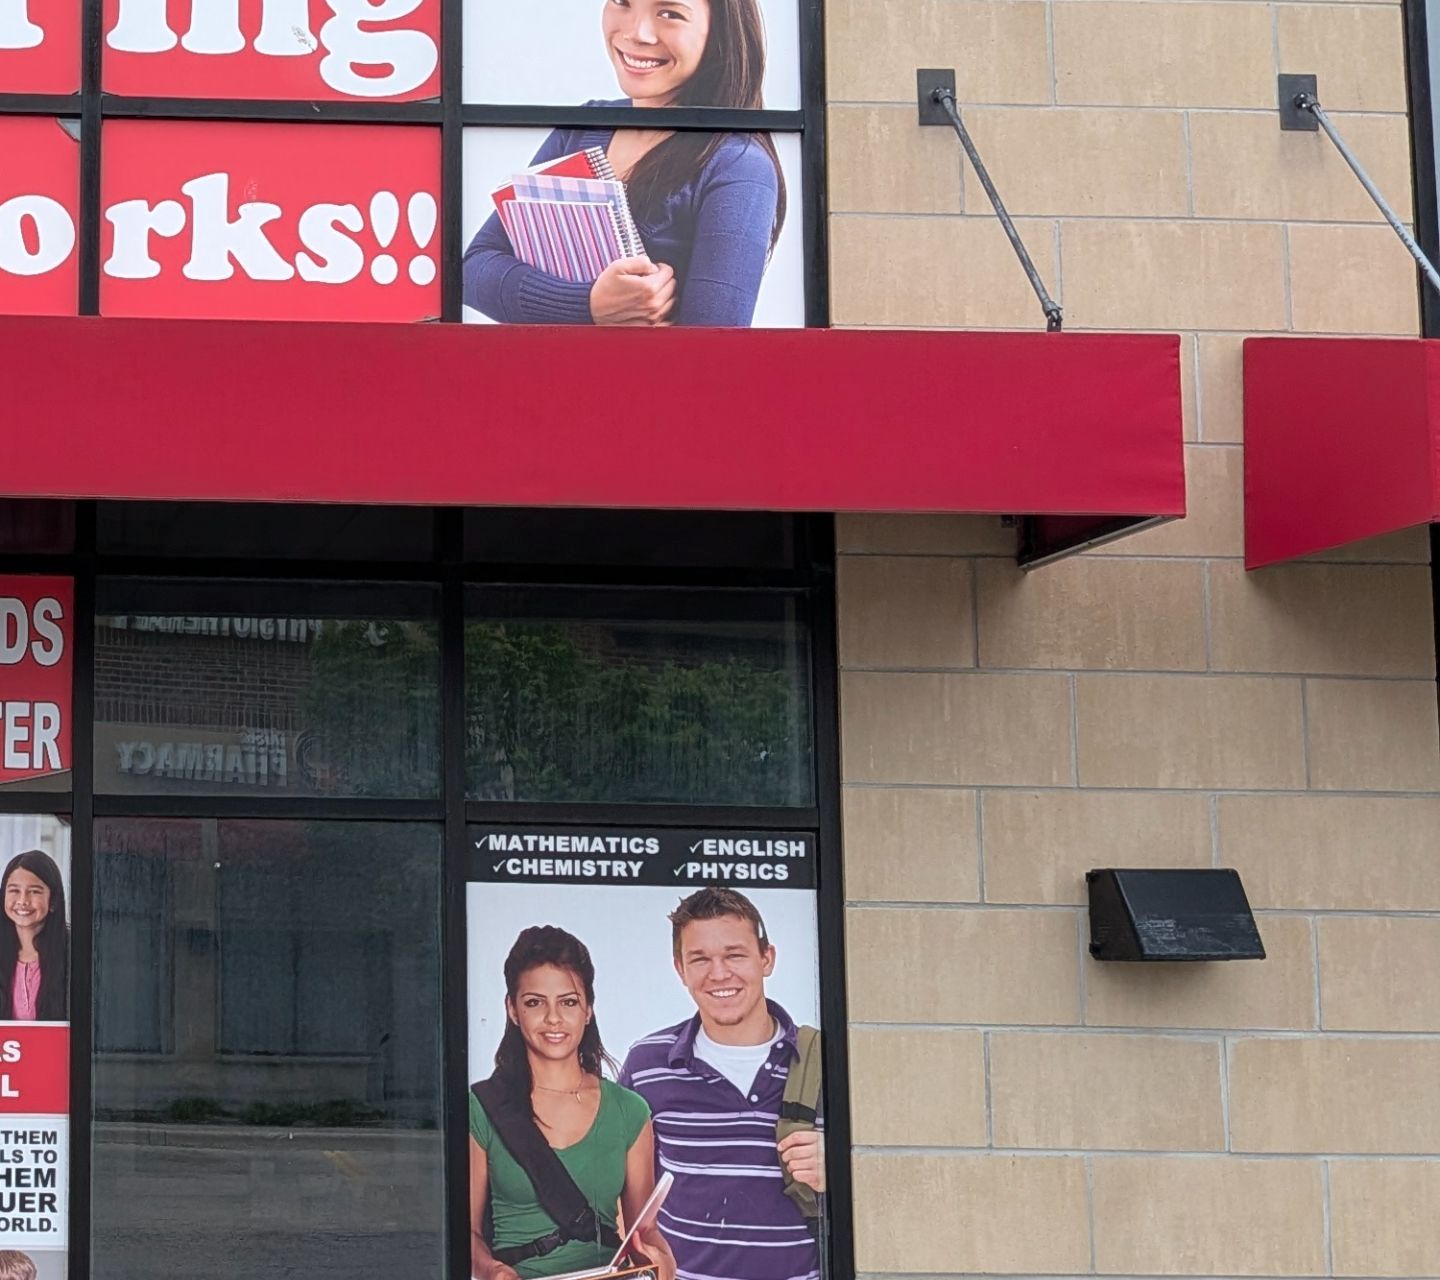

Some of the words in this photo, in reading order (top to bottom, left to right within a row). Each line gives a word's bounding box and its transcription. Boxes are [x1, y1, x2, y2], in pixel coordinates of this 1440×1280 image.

[488, 834, 660, 855] MATHEMATICS
[702, 839, 806, 858] ENGLISH
[506, 858, 645, 878] CHEMISTRY
[686, 862, 789, 881] PHYSICS
[0, 1130, 58, 1145] THEM
[30, 1149, 58, 1164] TO
